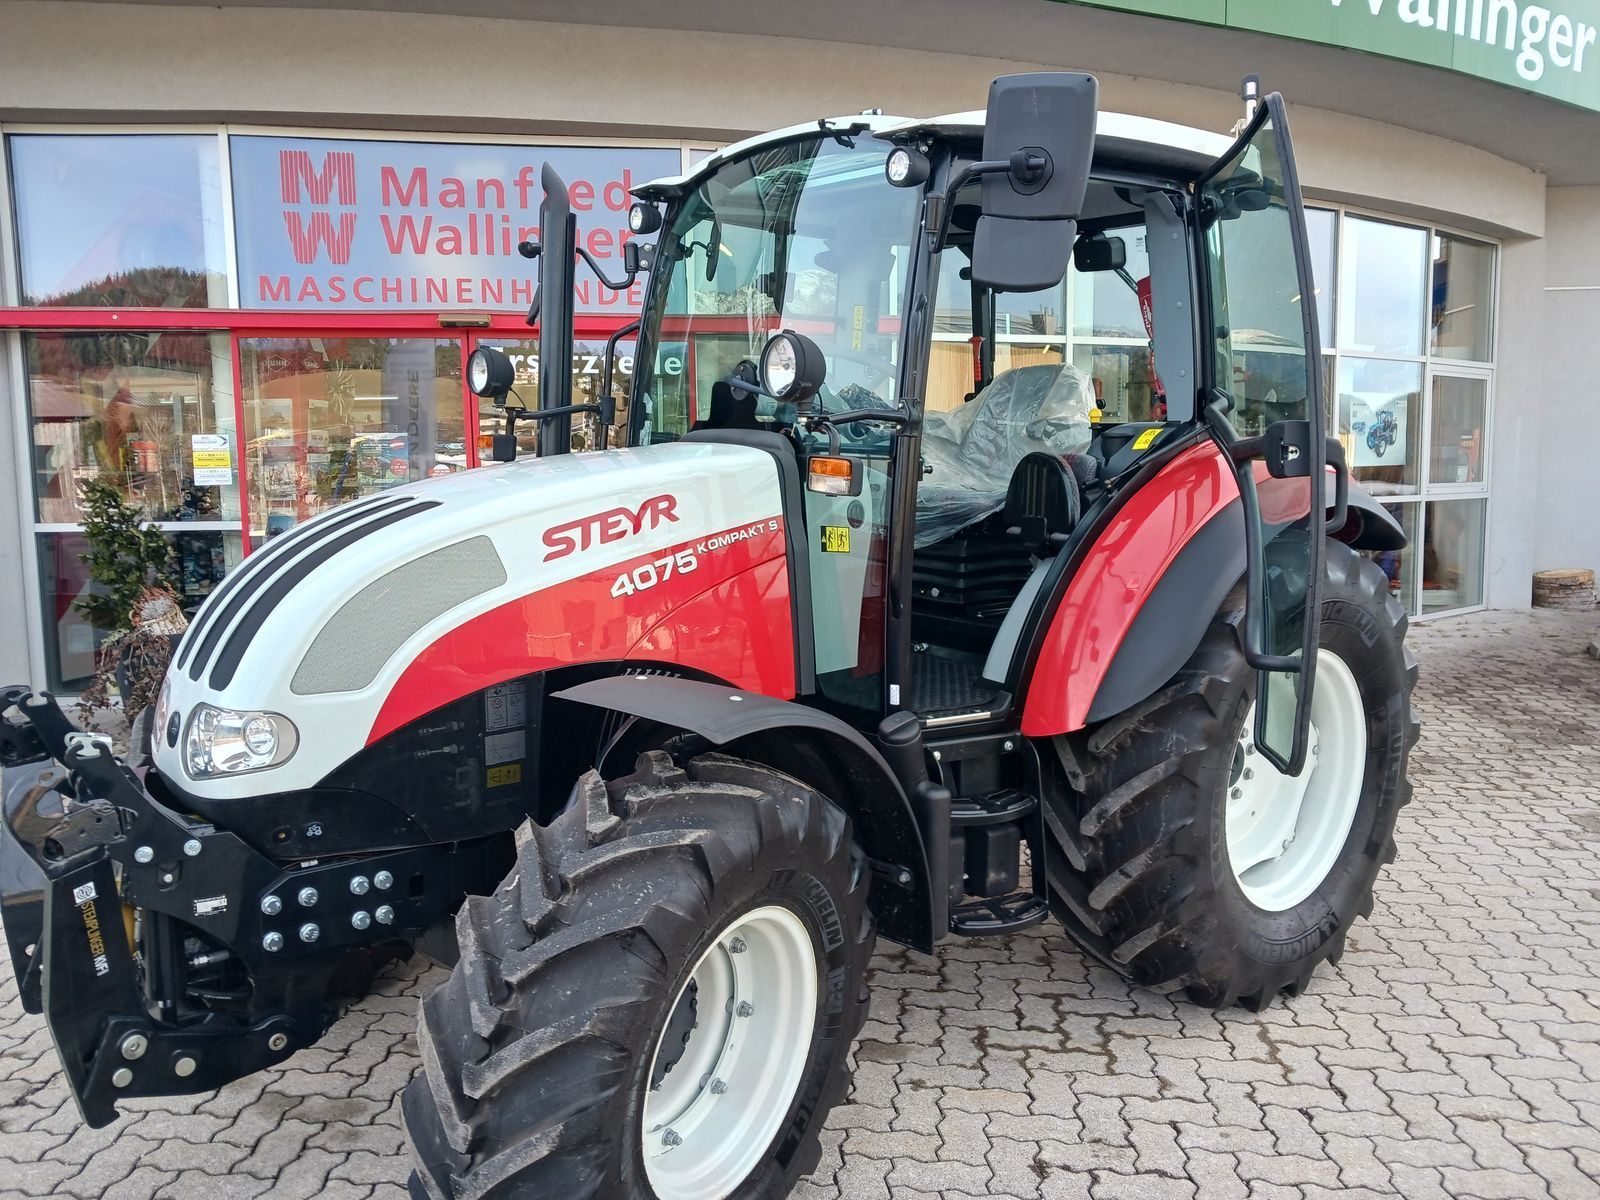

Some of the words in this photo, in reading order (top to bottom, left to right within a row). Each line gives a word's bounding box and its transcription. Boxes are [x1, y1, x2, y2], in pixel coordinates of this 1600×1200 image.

[1328, 0, 1597, 82] allinger
[380, 165, 632, 212] Manfed
[379, 213, 638, 267] Walliner
[258, 275, 642, 306] MASCHINENHNDE
[542, 493, 680, 563] STEYR
[609, 547, 699, 600] 4075
[696, 524, 766, 555] KOMPAKT
[769, 519, 779, 532] S
